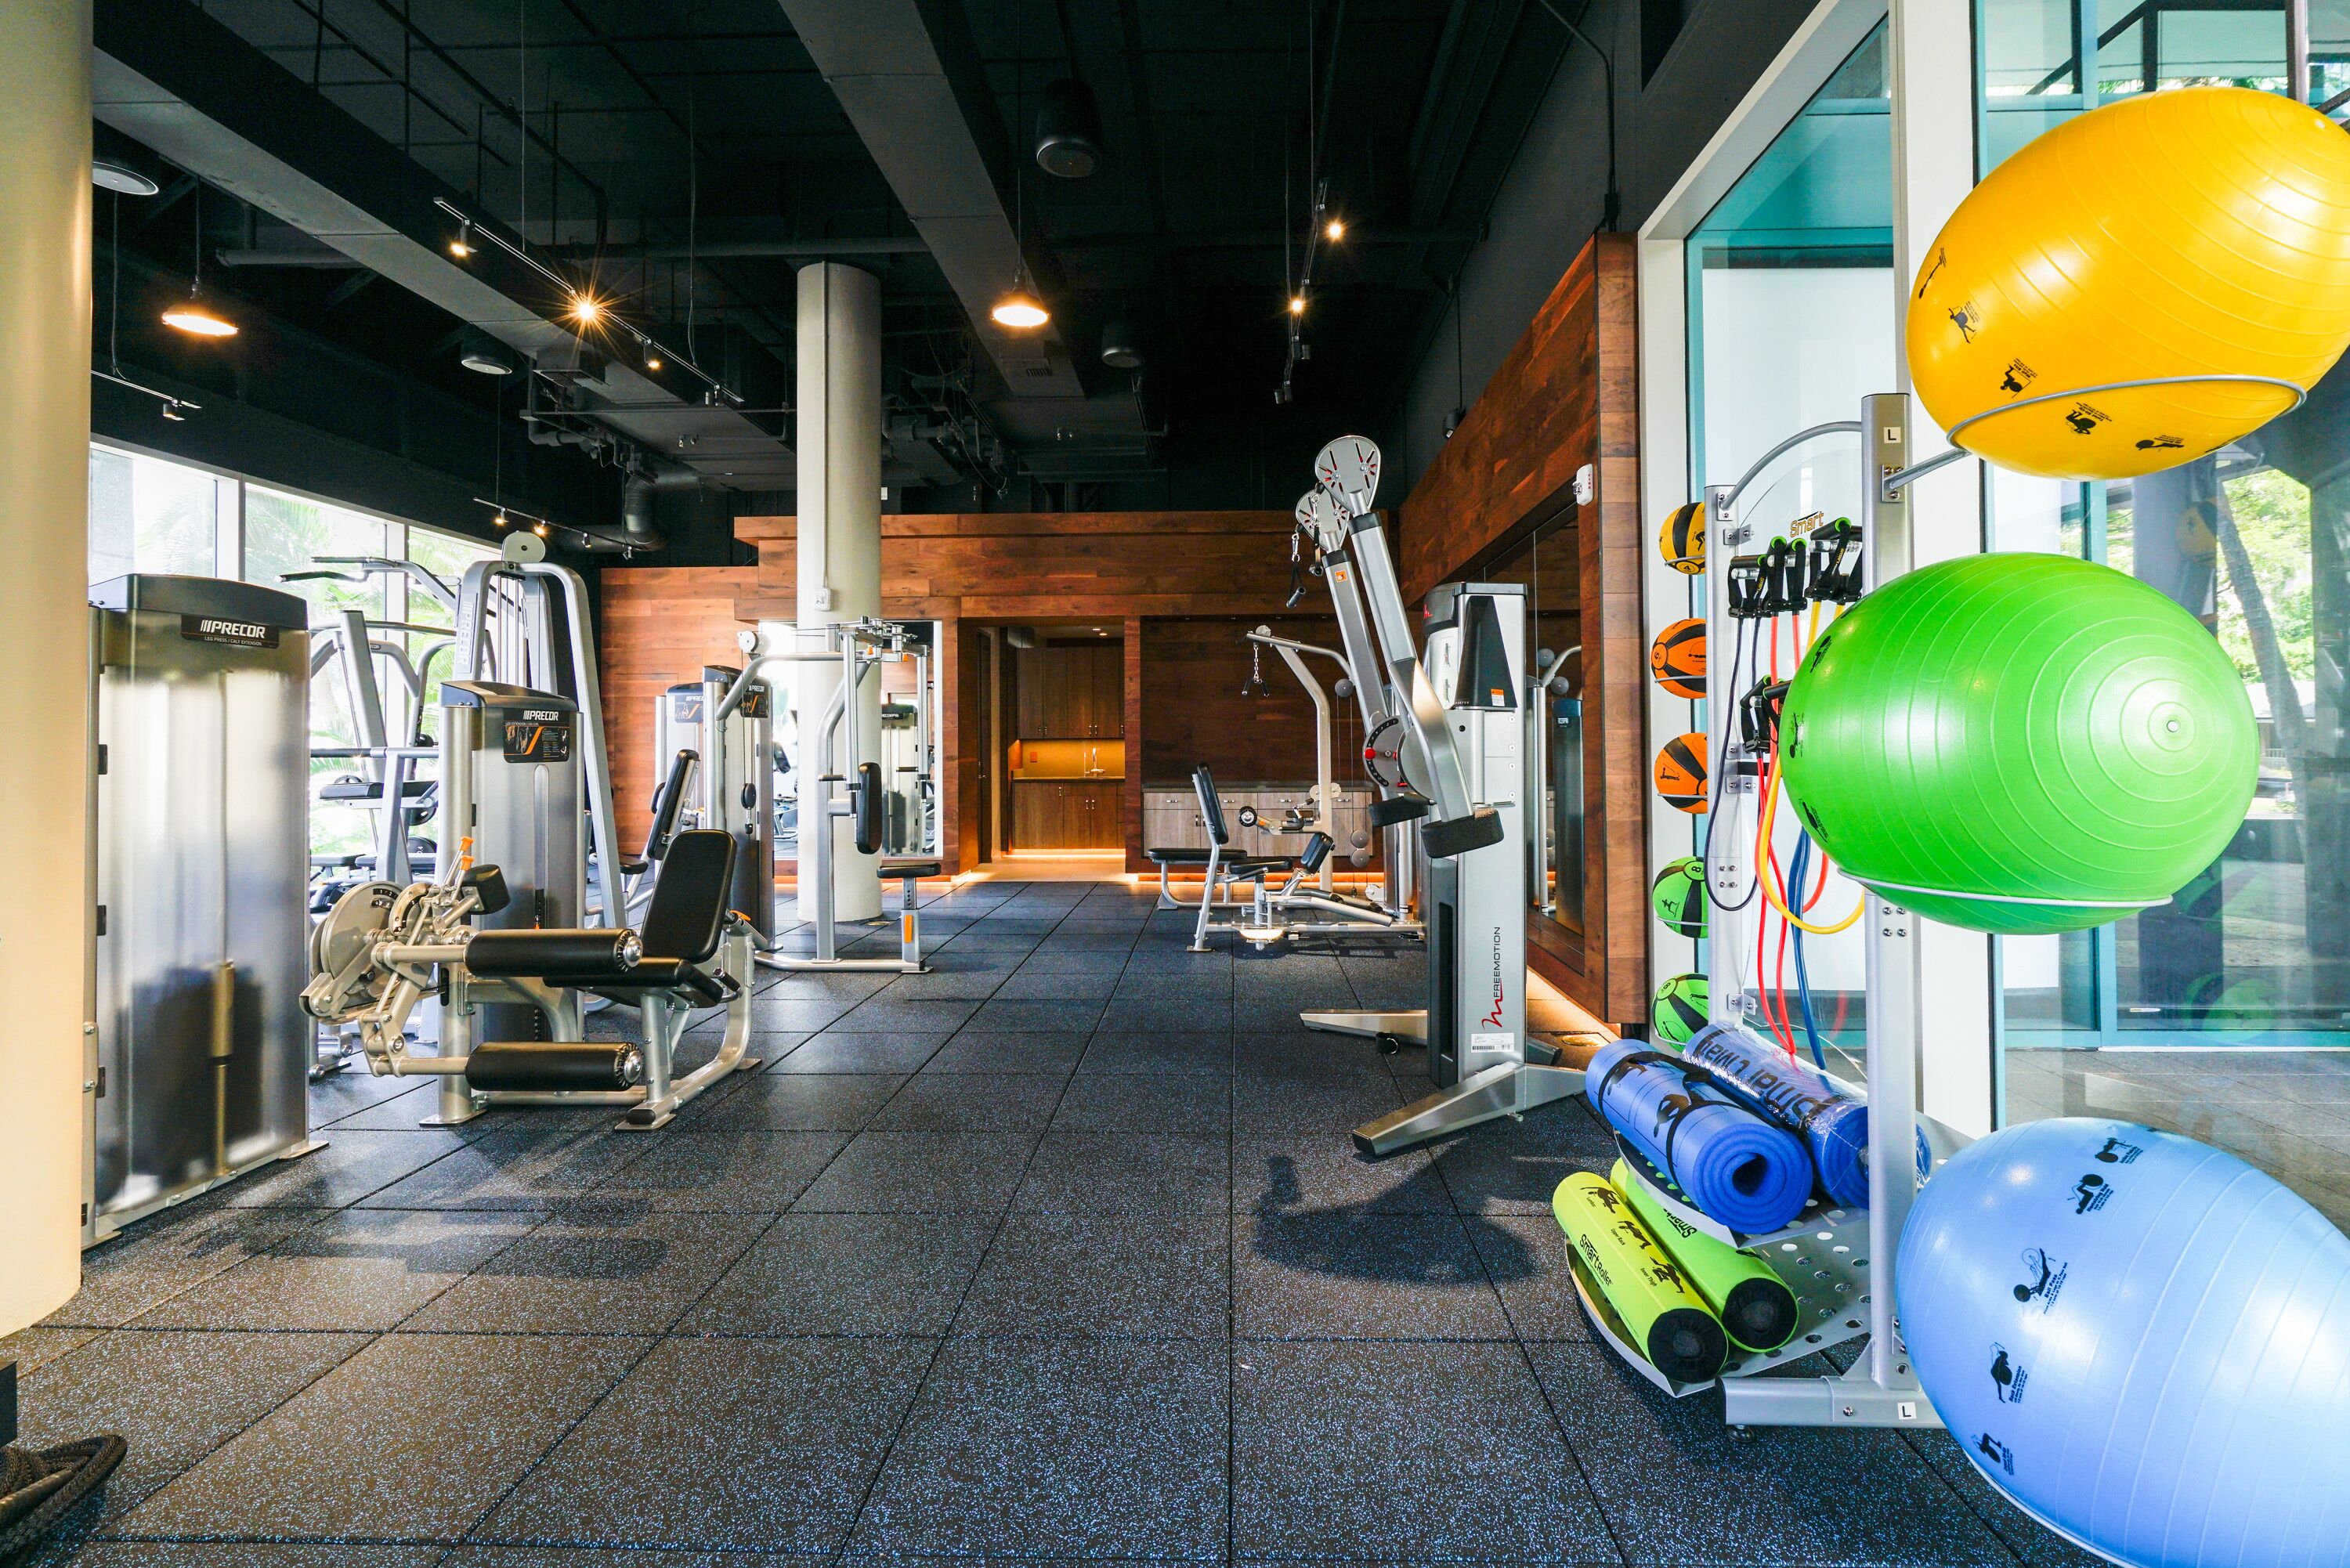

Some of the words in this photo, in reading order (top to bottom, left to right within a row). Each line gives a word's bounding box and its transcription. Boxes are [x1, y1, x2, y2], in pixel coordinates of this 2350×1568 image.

[1888, 429, 1896, 440] L
[1790, 511, 1824, 538] Smart
[211, 620, 266, 639] PRECOR
[529, 710, 559, 721] PRECOR
[2012, 1366, 2022, 1389] Extension
[1902, 1406, 1911, 1417] L
